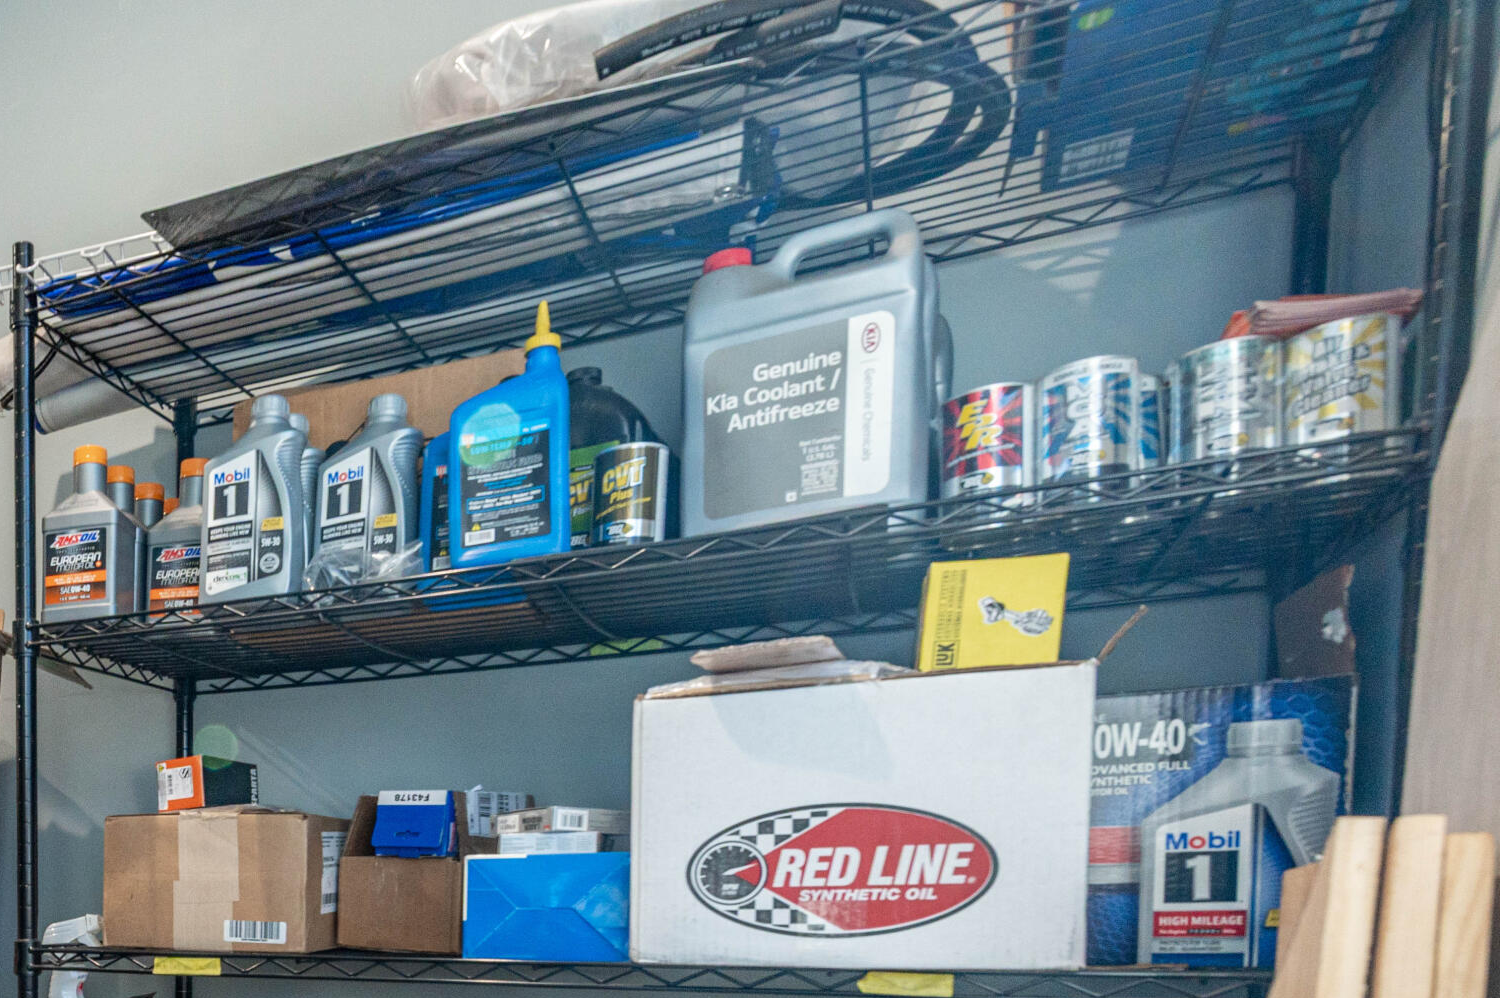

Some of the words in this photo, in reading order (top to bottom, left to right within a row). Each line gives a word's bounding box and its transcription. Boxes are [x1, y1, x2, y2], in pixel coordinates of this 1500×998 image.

[752, 351, 842, 383] Genuine
[706, 394, 738, 416] Kia
[743, 375, 825, 407] Coolant
[727, 397, 840, 433] Antifreeze
[213, 467, 250, 485] Mobil
[327, 466, 364, 485] Mobil
[602, 456, 647, 495] CVT
[223, 485, 236, 517] 1
[337, 484, 350, 515] 1
[609, 488, 633, 504] Plus
[50, 530, 100, 549] AMSOIL
[261, 536, 281, 547] 5W-30
[51, 552, 101, 567] EUROPEAN
[1095, 719, 1186, 759] 0W-40
[1091, 762, 1156, 776] DVANCED
[1158, 760, 1191, 771] FULL
[1091, 775, 1152, 788] YNTHETIC
[394, 793, 430, 803] F43178
[1114, 787, 1128, 796] OIL
[1165, 830, 1241, 850] Mobil
[772, 847, 862, 888] RED
[867, 843, 975, 885] LINE
[1186, 854, 1212, 901] 1
[799, 889, 901, 902] SYNTHETIC
[905, 888, 938, 901] OIL
[1158, 916, 1189, 926] HIGH
[1191, 915, 1244, 927] MILEAGE
